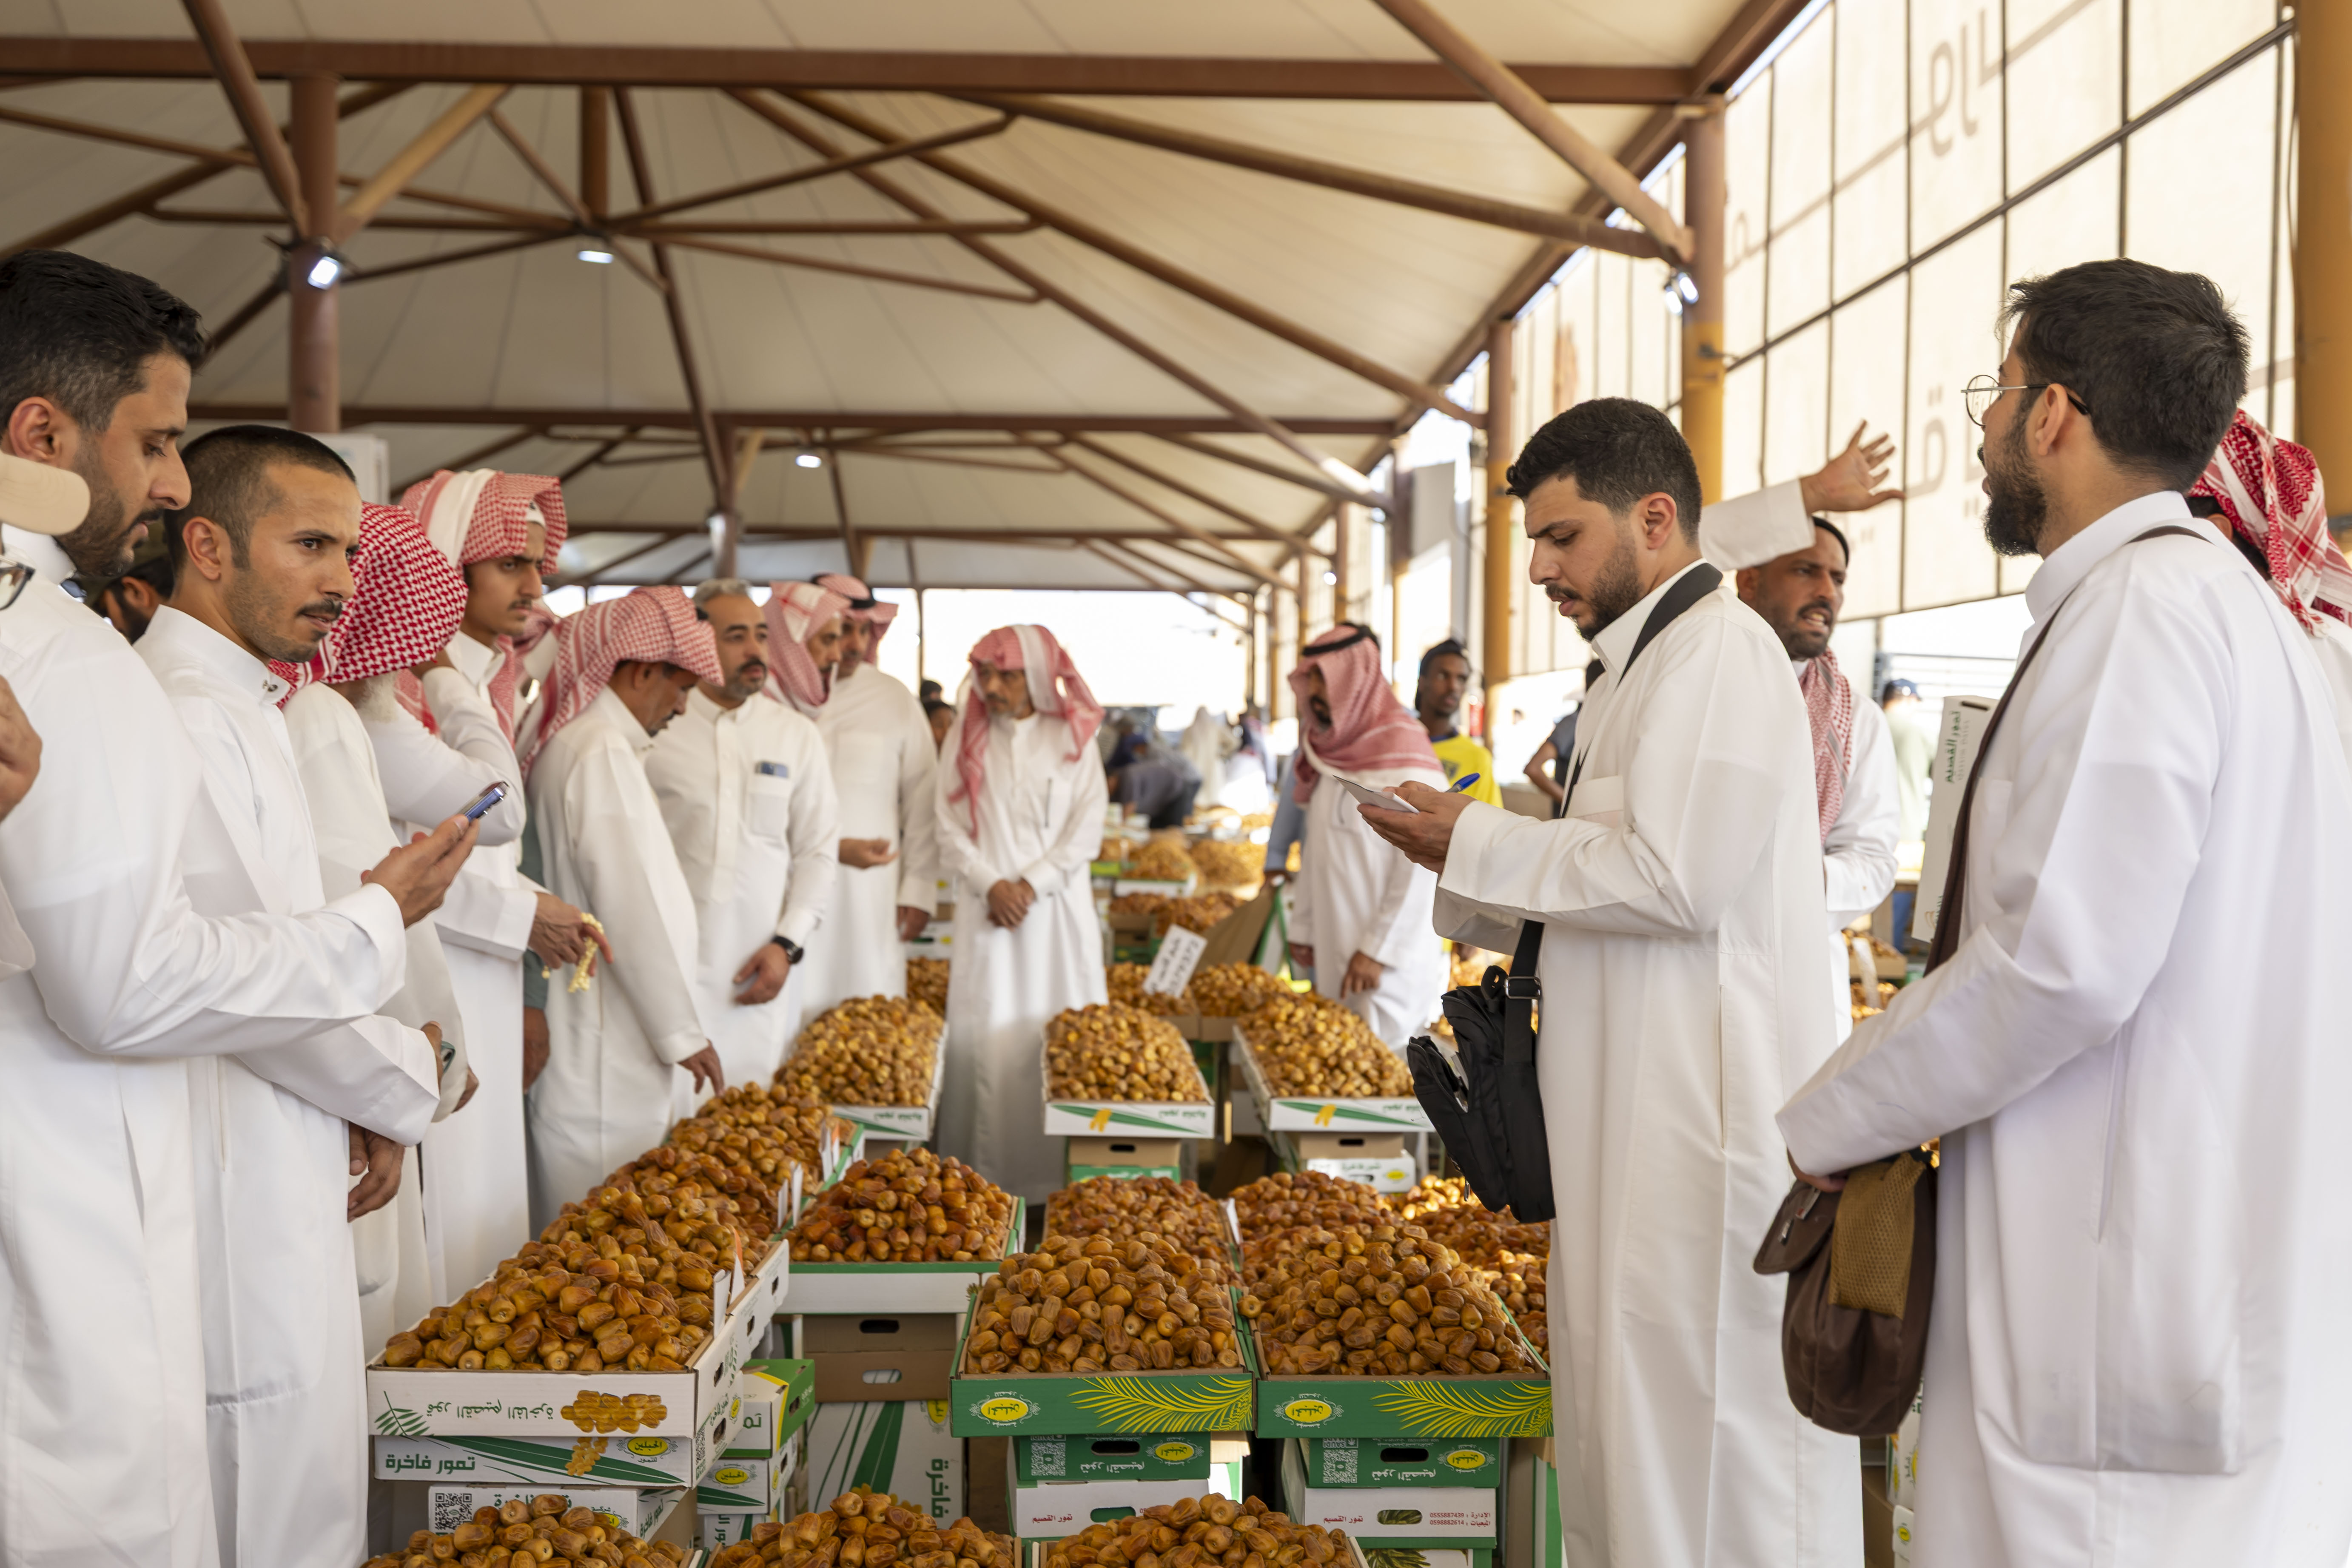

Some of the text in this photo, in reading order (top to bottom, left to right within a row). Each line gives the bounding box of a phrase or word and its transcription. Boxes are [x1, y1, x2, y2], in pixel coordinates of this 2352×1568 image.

[1945, 711, 1961, 784] تمور القصيم
[427, 1399, 553, 1420] تمور القصيم الفاخرة
[386, 1454, 476, 1474] تمور فاخرة
[1080, 1461, 1145, 1474] تمور القصيم
[1372, 1469, 1436, 1481] تمور القصيم
[925, 1458, 951, 1518] فاخرة
[1032, 1514, 1073, 1523] تمور القصيم
[1323, 1515, 1364, 1524] تمور القصيم
